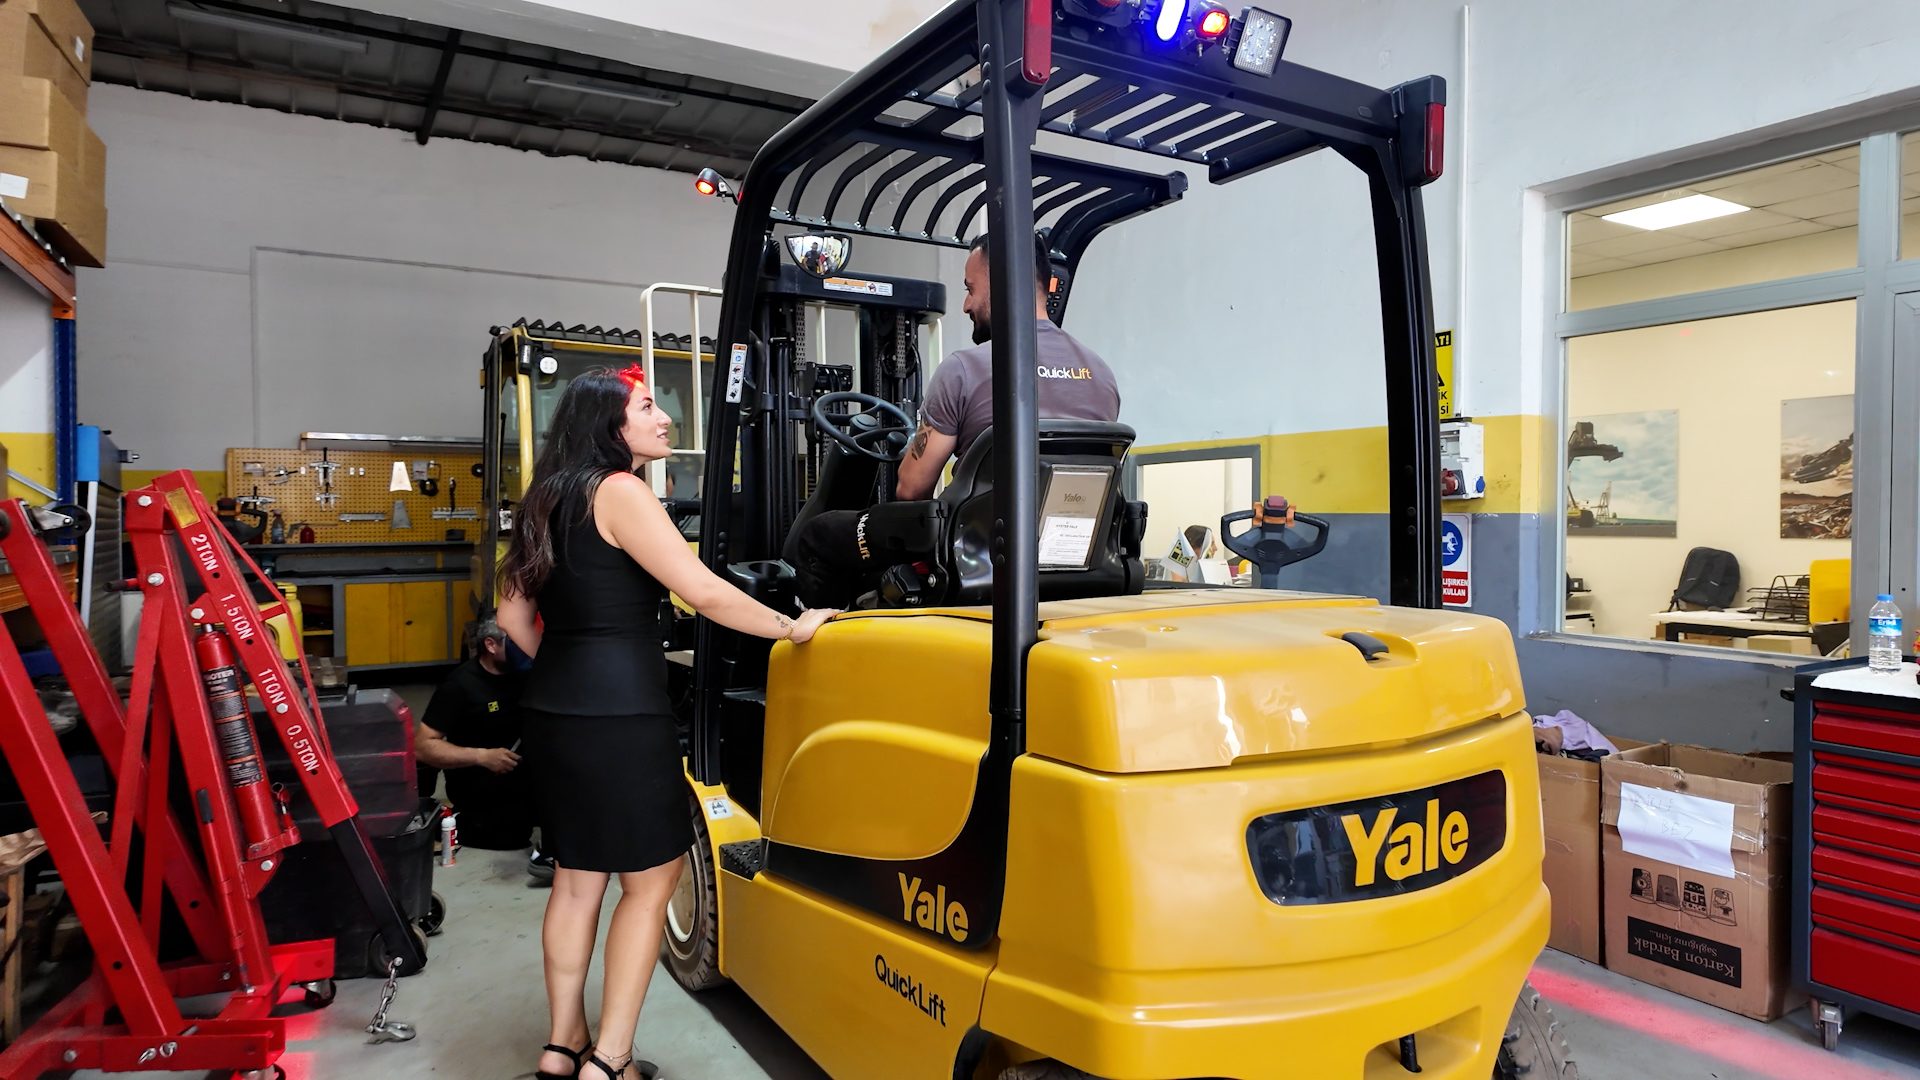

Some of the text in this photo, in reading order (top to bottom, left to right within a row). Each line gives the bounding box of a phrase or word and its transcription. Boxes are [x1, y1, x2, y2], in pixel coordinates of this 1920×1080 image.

[1037, 365, 1092, 379] QuickLift
[191, 533, 219, 571] 2TON
[1442, 578, 1469, 588] LIŞIRKEN
[220, 593, 254, 640] 1.5TON
[258, 668, 288, 704] 1TON
[286, 724, 320, 772] 0.5TON
[1340, 798, 1469, 887] Yale
[898, 872, 969, 943] Yale
[1634, 936, 1735, 978] Karton Bardak
[875, 954, 946, 1028] QuickLift
